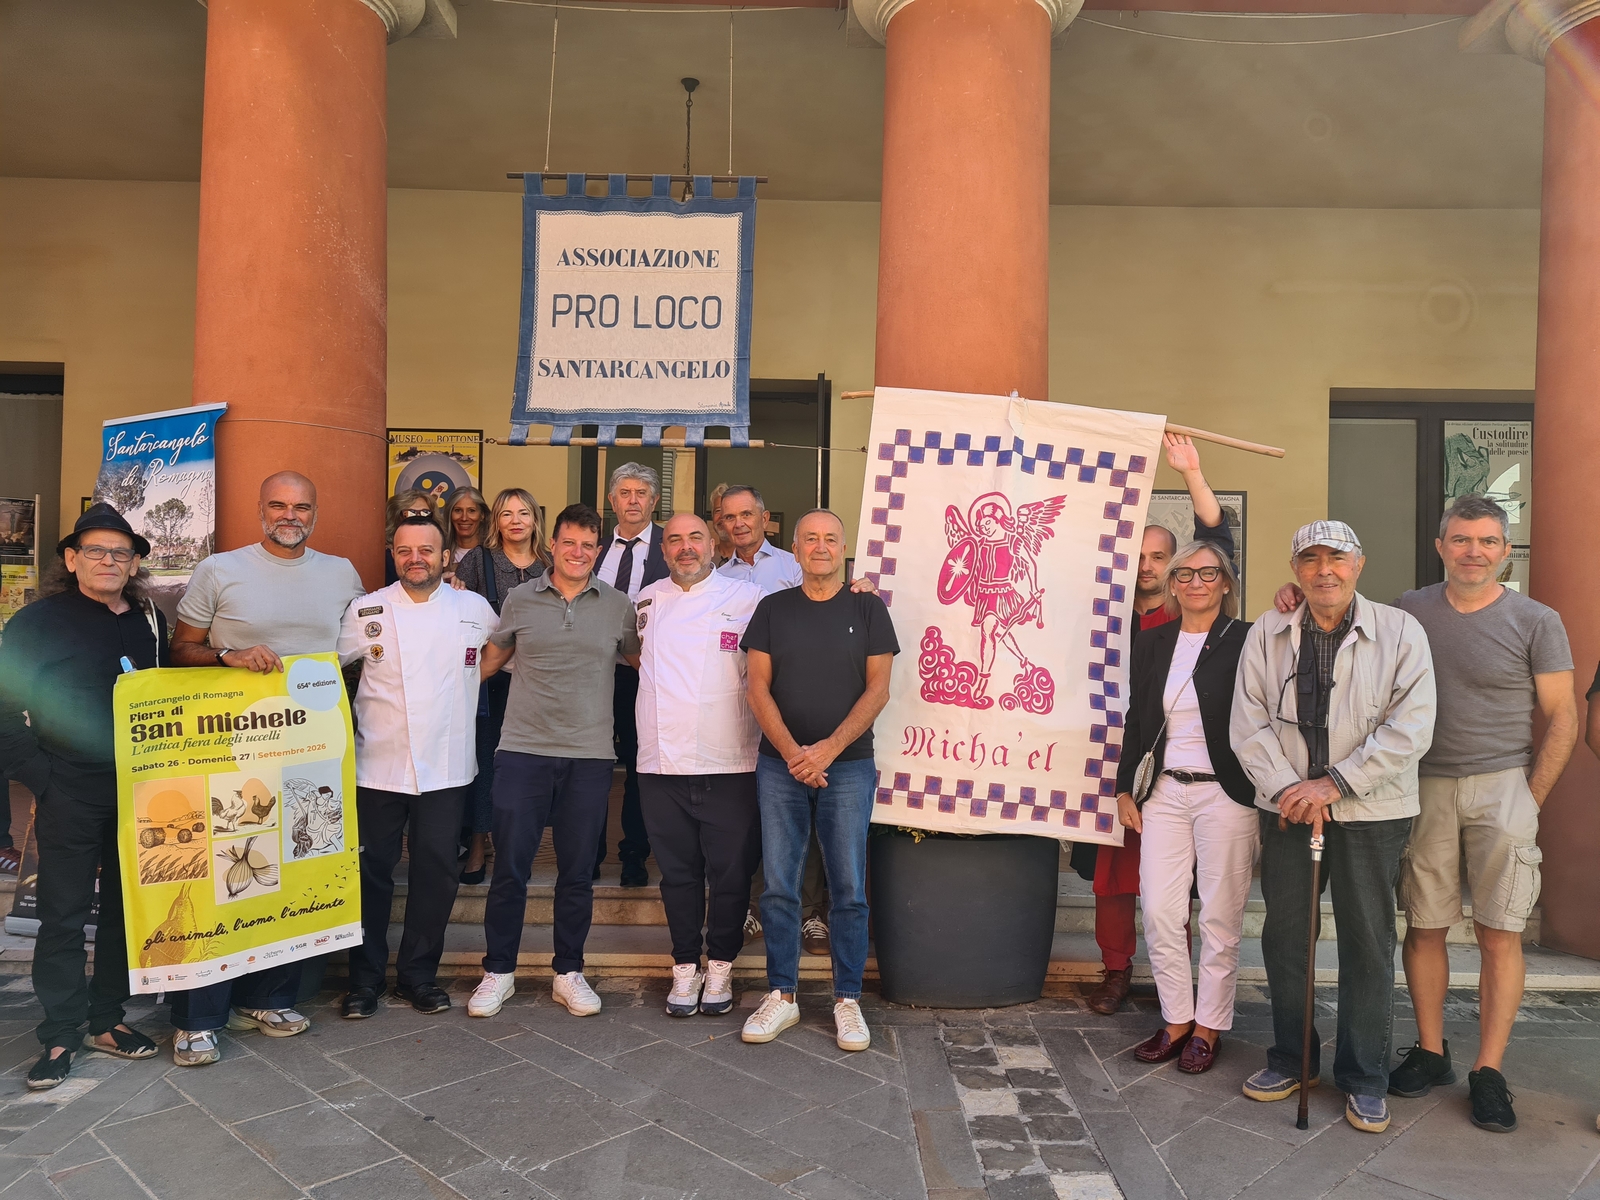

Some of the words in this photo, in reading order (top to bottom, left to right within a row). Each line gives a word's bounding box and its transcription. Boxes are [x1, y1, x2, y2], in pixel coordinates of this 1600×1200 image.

[556, 247, 720, 269] ASSOCIAZIONE
[551, 293, 620, 329] PRO
[633, 295, 722, 329] LOCO
[537, 358, 731, 380] SANTARCANGELO
[390, 434, 423, 444] MUSEO
[436, 435, 479, 444] BOTTONE
[1472, 426, 1529, 440] Custodire
[1487, 440, 1494, 448] la
[1495, 440, 1529, 448] solitudine
[106, 423, 209, 466] Santarcangelo
[1489, 448, 1506, 456] delle
[1507, 448, 1529, 457] poesie
[121, 465, 139, 487] di
[143, 458, 213, 499] Romagna
[312, 680, 337, 688] edizione
[129, 694, 191, 710] Santarcangelo
[203, 690, 244, 700] Romagna
[129, 710, 165, 723] Fiera
[171, 705, 184, 716] di
[130, 721, 184, 743] San
[131, 740, 180, 756] L'antica
[180, 737, 210, 751] fiera
[213, 733, 244, 747] degli
[245, 730, 281, 743] uccelli
[131, 763, 165, 773] Sabato
[167, 760, 180, 768] 26
[188, 755, 237, 765] Domenica
[239, 753, 251, 761] 27
[257, 748, 305, 759] Settembre
[306, 743, 327, 752] 2026
[901, 725, 1057, 772] Micha'el
[143, 932, 165, 950] gli
[168, 923, 229, 943] animali,
[279, 897, 346, 919] l'ambiente
